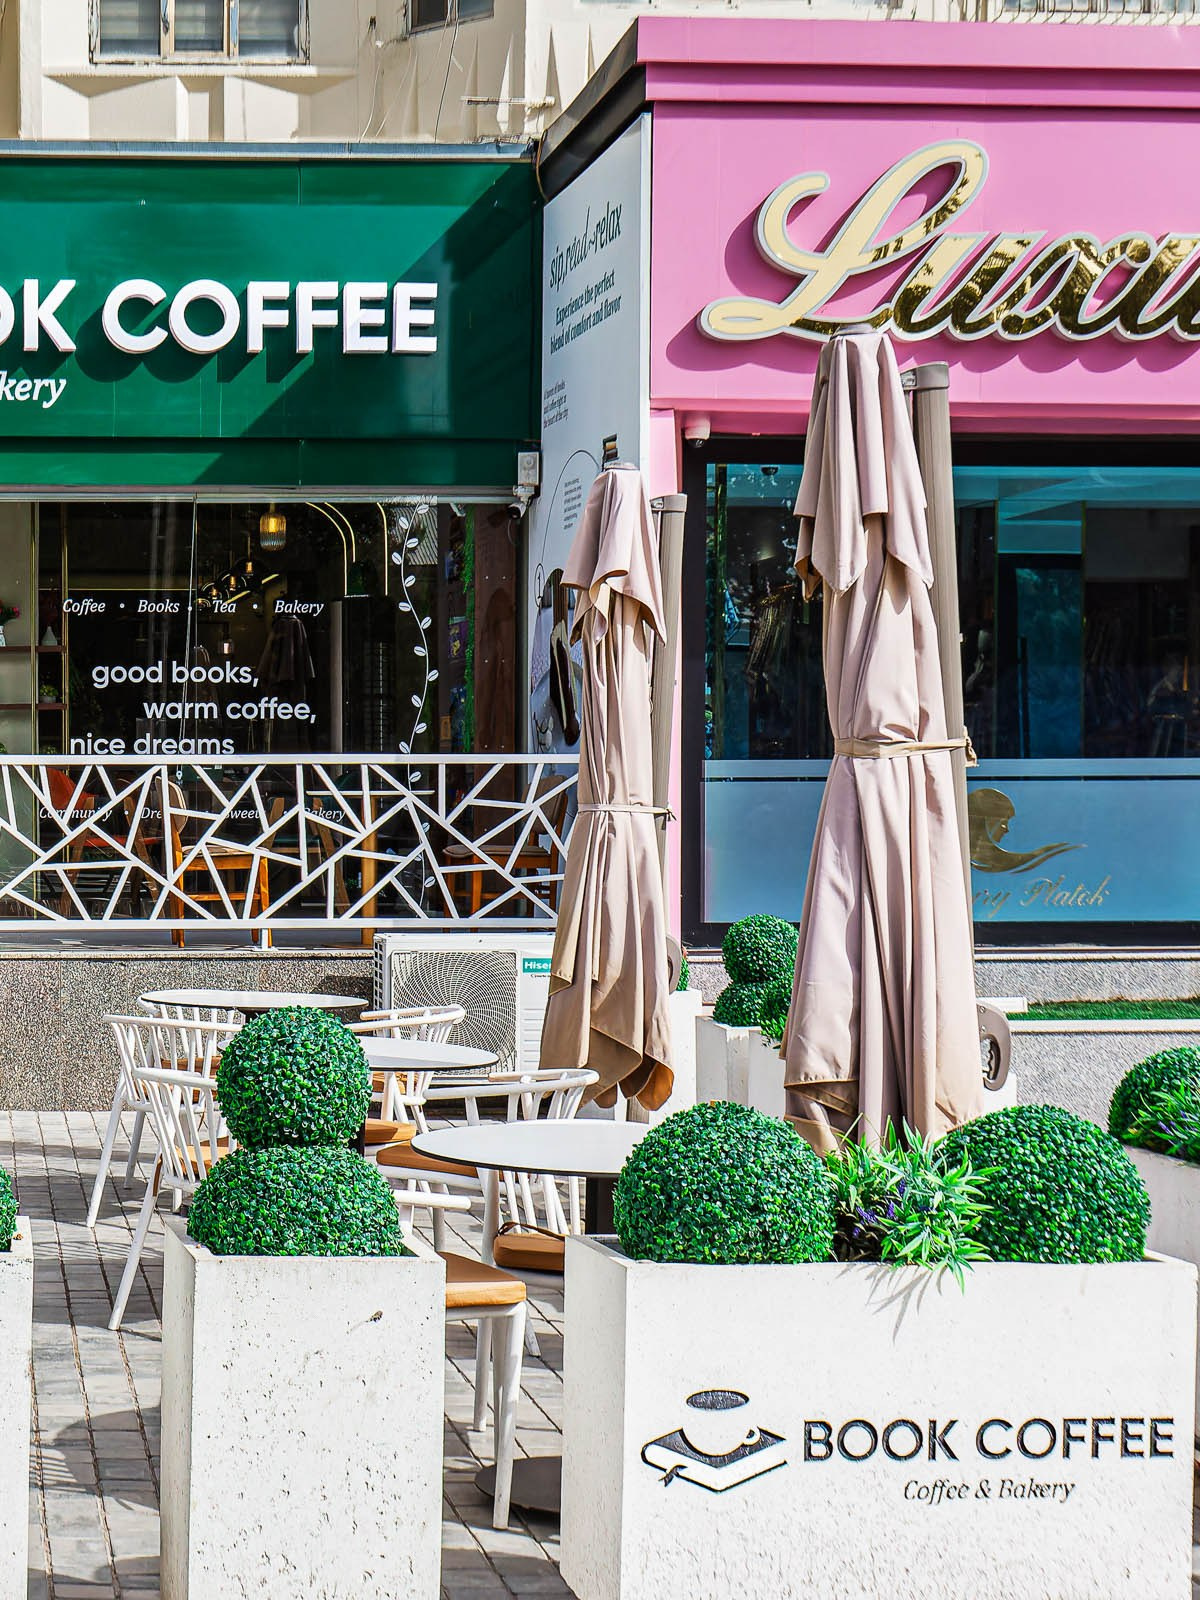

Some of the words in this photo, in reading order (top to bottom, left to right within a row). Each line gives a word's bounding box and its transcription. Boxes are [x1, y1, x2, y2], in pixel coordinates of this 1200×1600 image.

[556, 293, 584, 327] Experience
[584, 284, 594, 306] the
[594, 270, 615, 304] perfect
[103, 279, 438, 353] COFFEE
[550, 330, 565, 355] blend
[571, 314, 592, 341] comfort
[593, 302, 604, 326] and
[62, 597, 107, 617] Coffee
[136, 597, 181, 615] Books
[212, 597, 237, 615] Tea
[273, 598, 325, 619] Bakery
[91, 660, 163, 689] good
[172, 660, 259, 688] books,
[143, 701, 219, 722] warm
[225, 697, 318, 724] coffee,
[69, 732, 127, 755] nice
[132, 732, 236, 755] dreams
[39, 806, 113, 822] Cmmuny
[803, 1418, 959, 1462] BOOK
[975, 1416, 1174, 1460] COFFEE
[904, 1479, 970, 1505] Coffee
[974, 1479, 991, 1500] &
[998, 1477, 1076, 1502] Bakery
